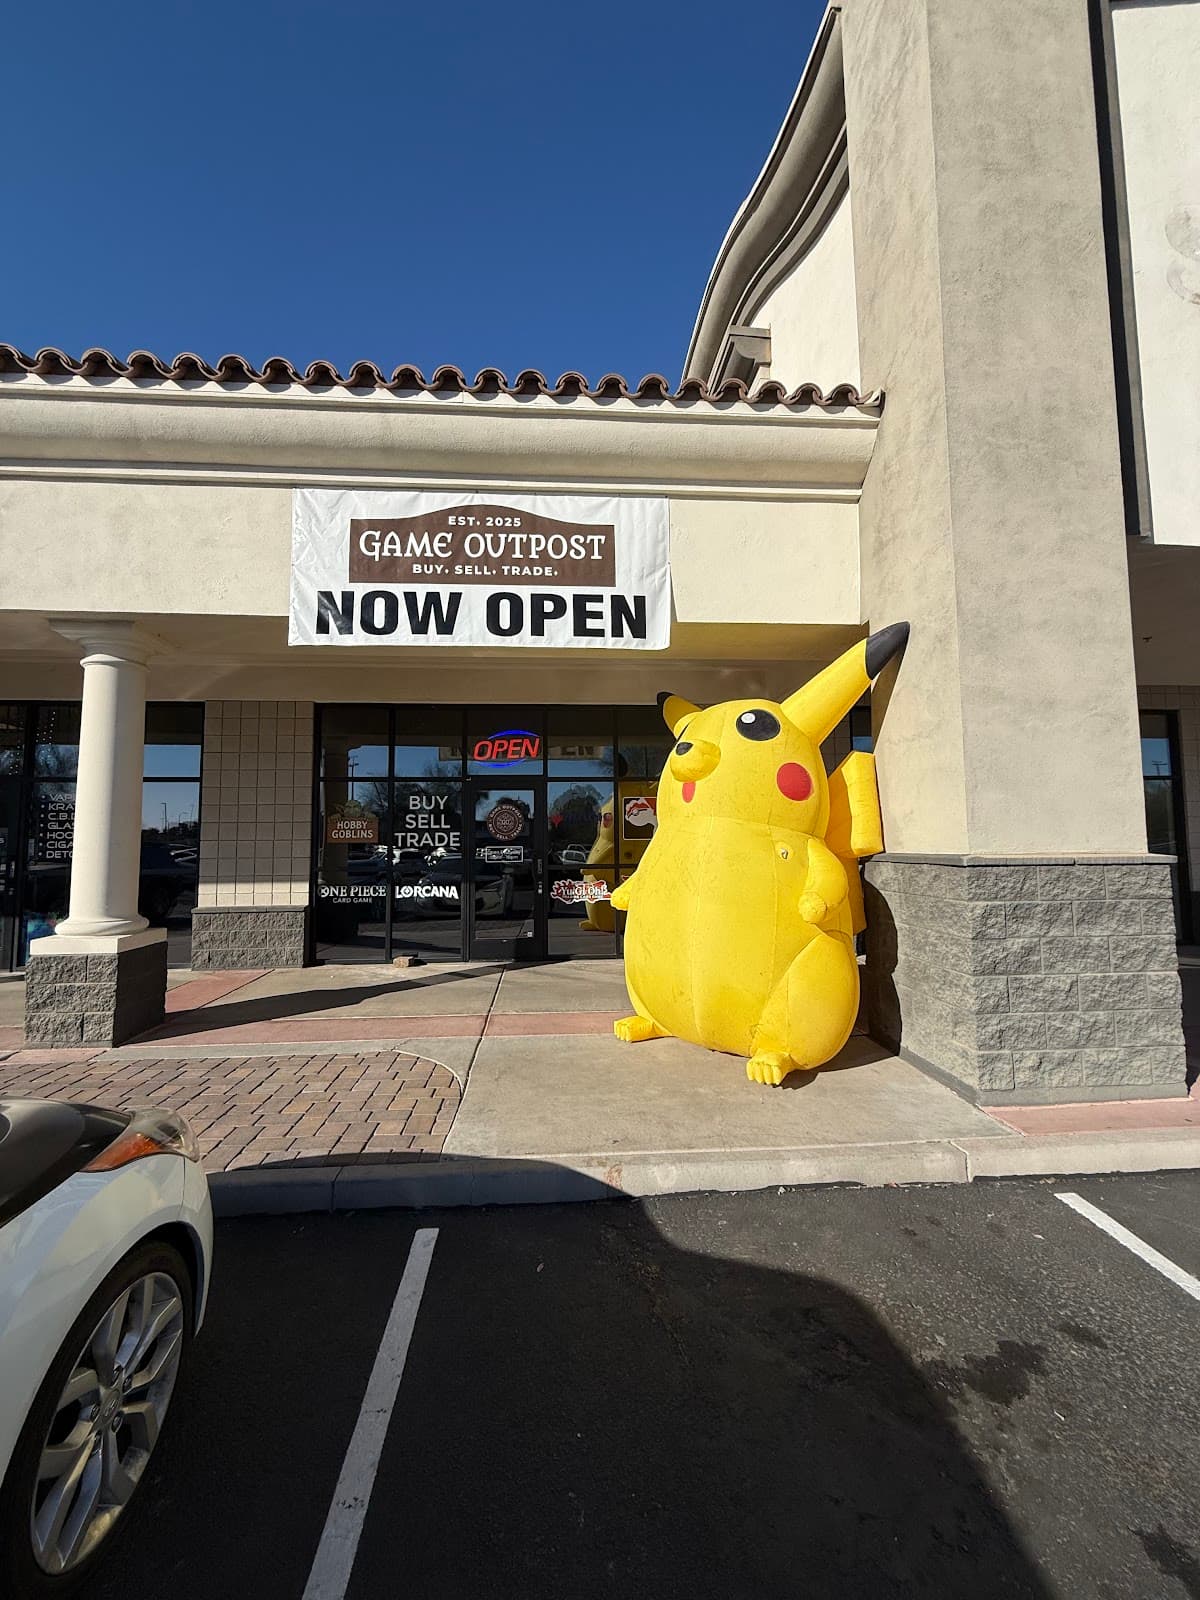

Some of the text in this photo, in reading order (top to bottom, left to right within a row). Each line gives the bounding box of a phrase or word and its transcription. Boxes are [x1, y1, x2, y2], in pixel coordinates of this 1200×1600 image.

[448, 516, 522, 528] EST. 2025
[359, 530, 606, 561] GAME OUTPOST
[412, 564, 559, 577] BUY. SELL. TRADE.
[316, 590, 647, 640] NOW OPEN
[473, 737, 541, 761] OPEN
[49, 793, 76, 801] VAP
[409, 795, 449, 810] BUY
[48, 803, 76, 811] KRA
[47, 822, 75, 830] GLA
[337, 820, 368, 830] HOBBY
[405, 814, 451, 829] SELL
[331, 829, 374, 839] GOBLINS
[394, 832, 461, 847] TRADE
[318, 885, 387, 898] ONE PIECE
[395, 885, 460, 899] LORCANA
